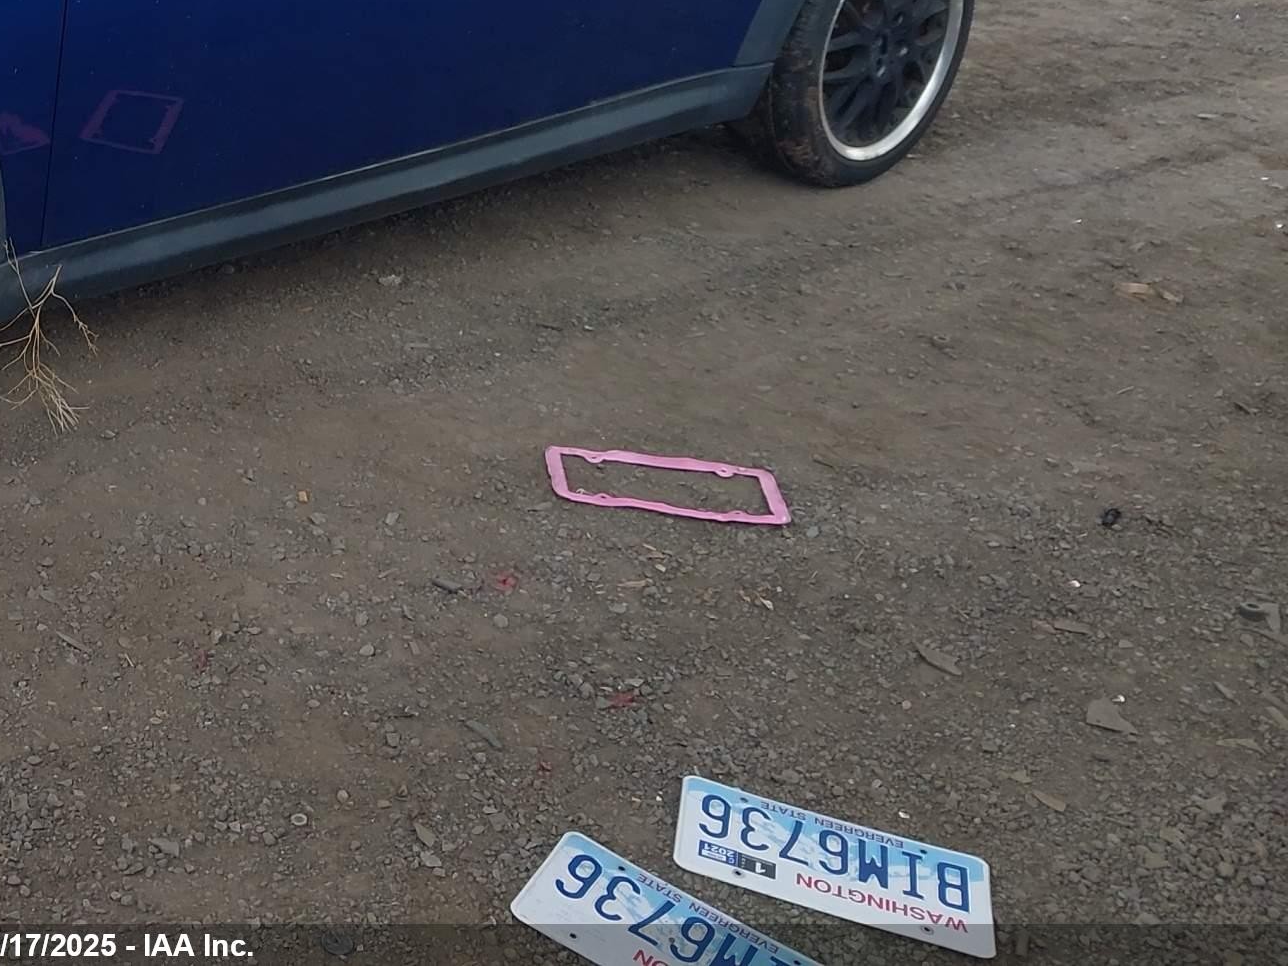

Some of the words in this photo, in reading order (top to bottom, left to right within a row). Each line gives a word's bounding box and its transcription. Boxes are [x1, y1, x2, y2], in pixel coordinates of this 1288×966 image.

[761, 801, 808, 820] STATE
[699, 794, 971, 913] BIM6736
[704, 843, 735, 857] 2021
[814, 817, 905, 849] EVERGREEN
[637, 873, 683, 903] STATE
[795, 873, 968, 933] WASHINGTON
[555, 853, 788, 966] M6736
[689, 902, 779, 954] EVERGREEN
